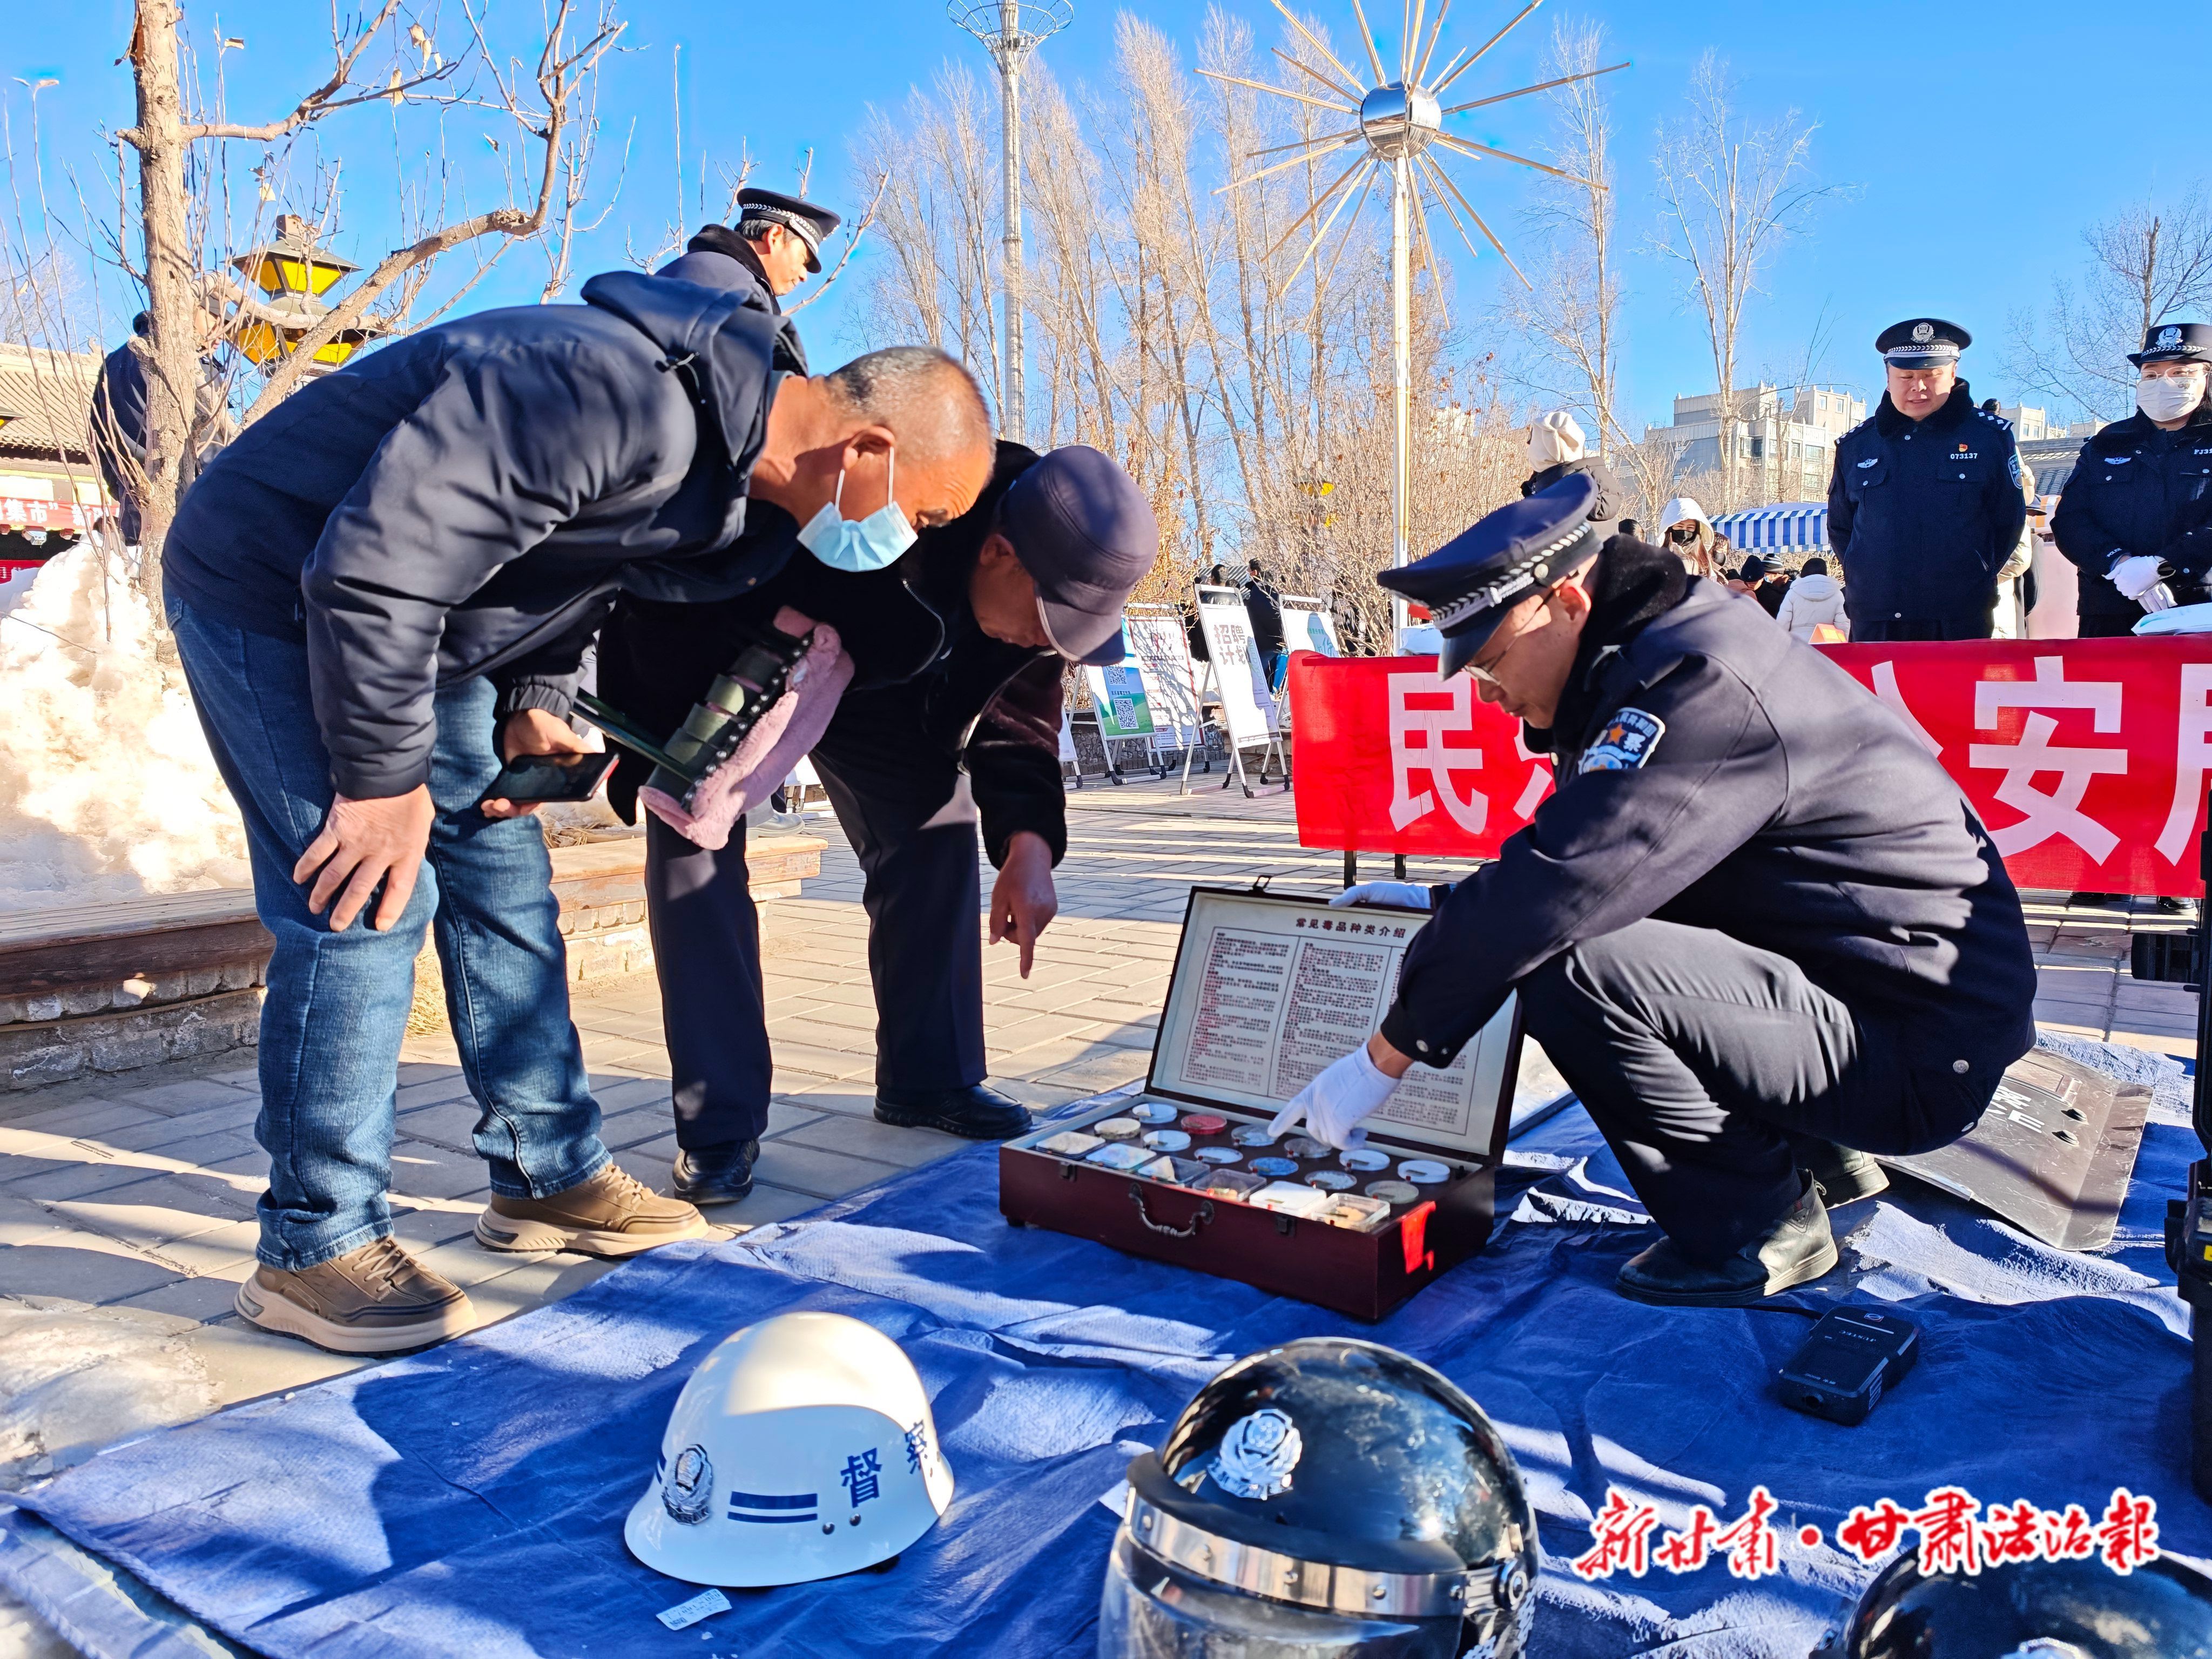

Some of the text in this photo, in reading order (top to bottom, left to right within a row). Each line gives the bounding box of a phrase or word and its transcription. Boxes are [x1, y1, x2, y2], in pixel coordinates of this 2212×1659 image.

[0, 498, 58, 524] 集市”
[1213, 624, 1246, 645] 招聘
[1296, 917, 1406, 939] 常见毒品种类介绍
[840, 1419, 928, 1509] 督察
